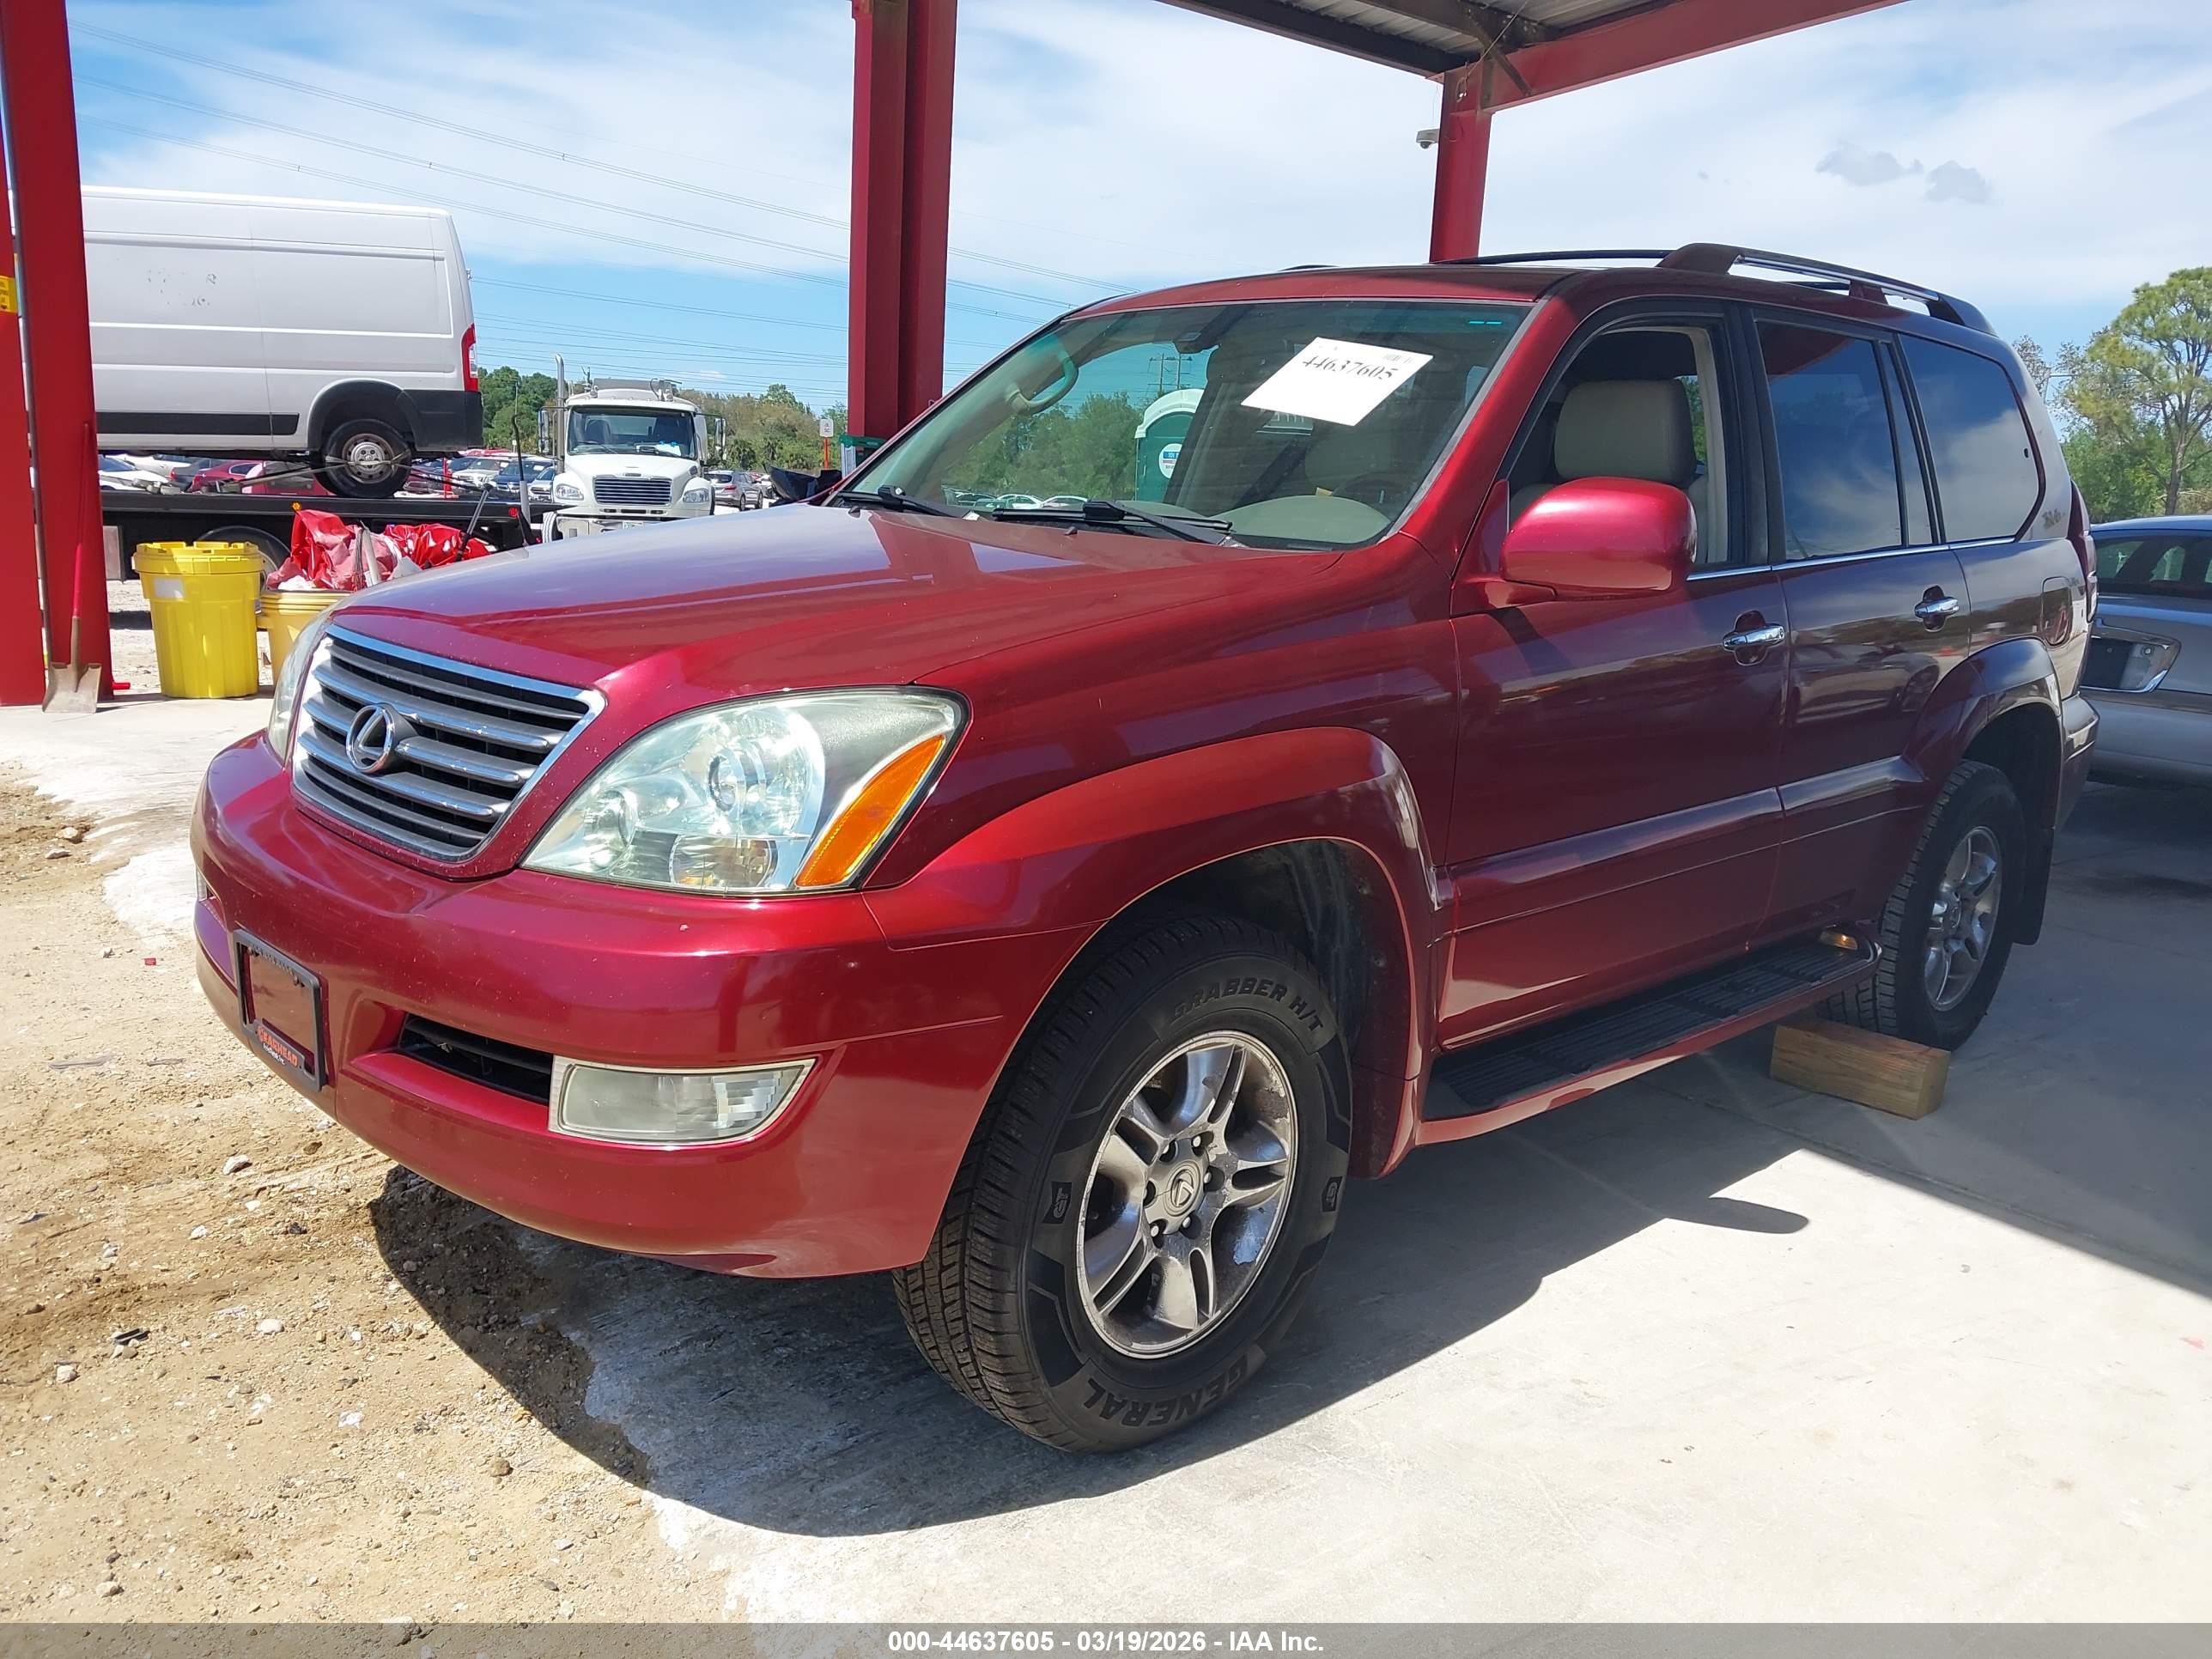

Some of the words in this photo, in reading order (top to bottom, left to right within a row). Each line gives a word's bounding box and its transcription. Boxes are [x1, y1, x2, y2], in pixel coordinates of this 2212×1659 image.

[1302, 356, 1400, 380] 44637605
[1170, 977, 1289, 1023] GRABBER
[1289, 995, 1324, 1031] H/T
[1083, 1354, 1248, 1427] GENERAL
